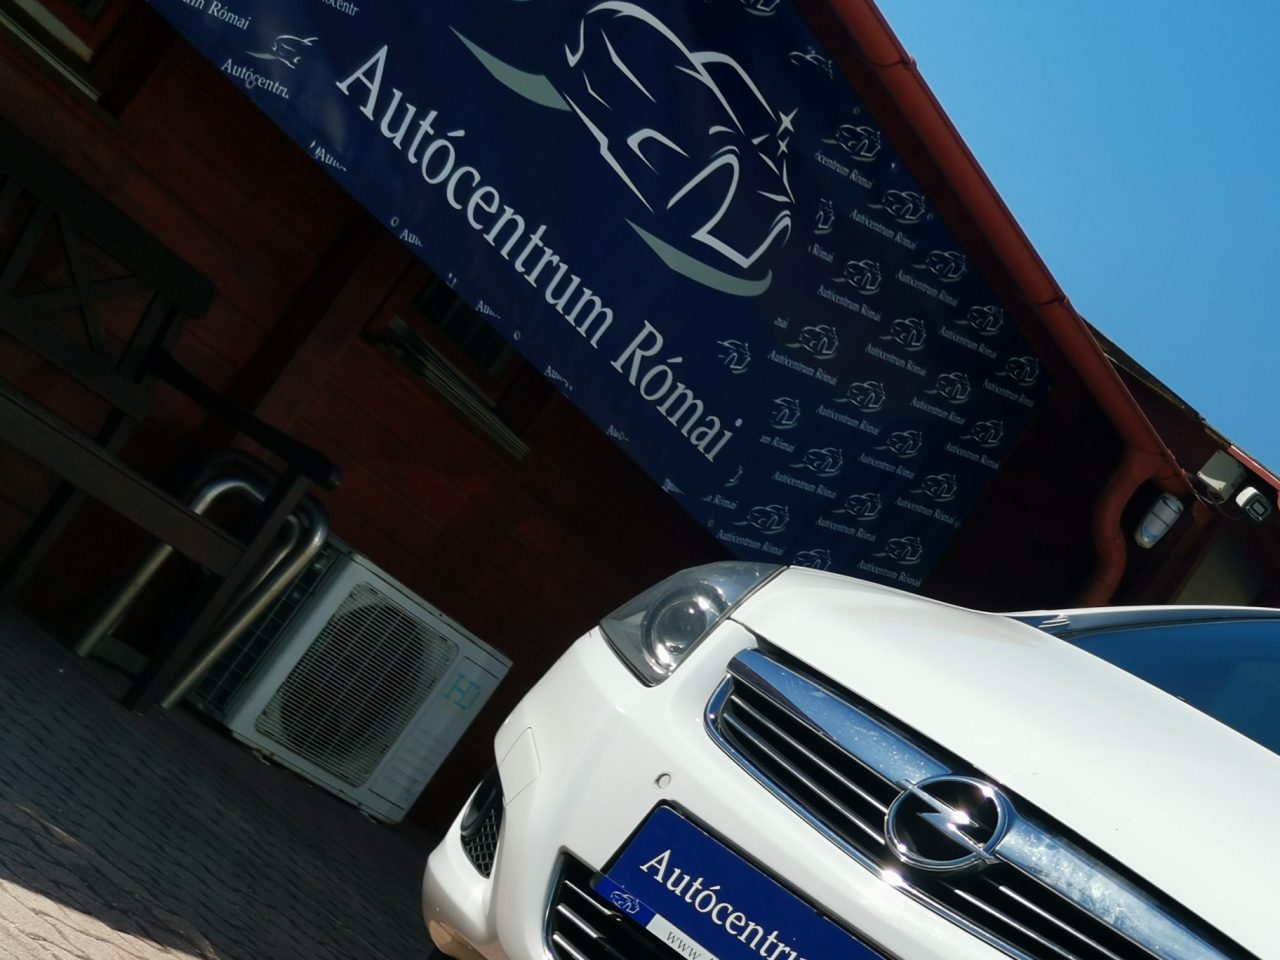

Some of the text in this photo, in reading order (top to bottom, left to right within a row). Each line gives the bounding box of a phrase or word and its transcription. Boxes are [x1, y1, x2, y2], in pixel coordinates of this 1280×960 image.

[208, 1, 251, 30] Római
[336, 45, 743, 463] Autócentrum Római
